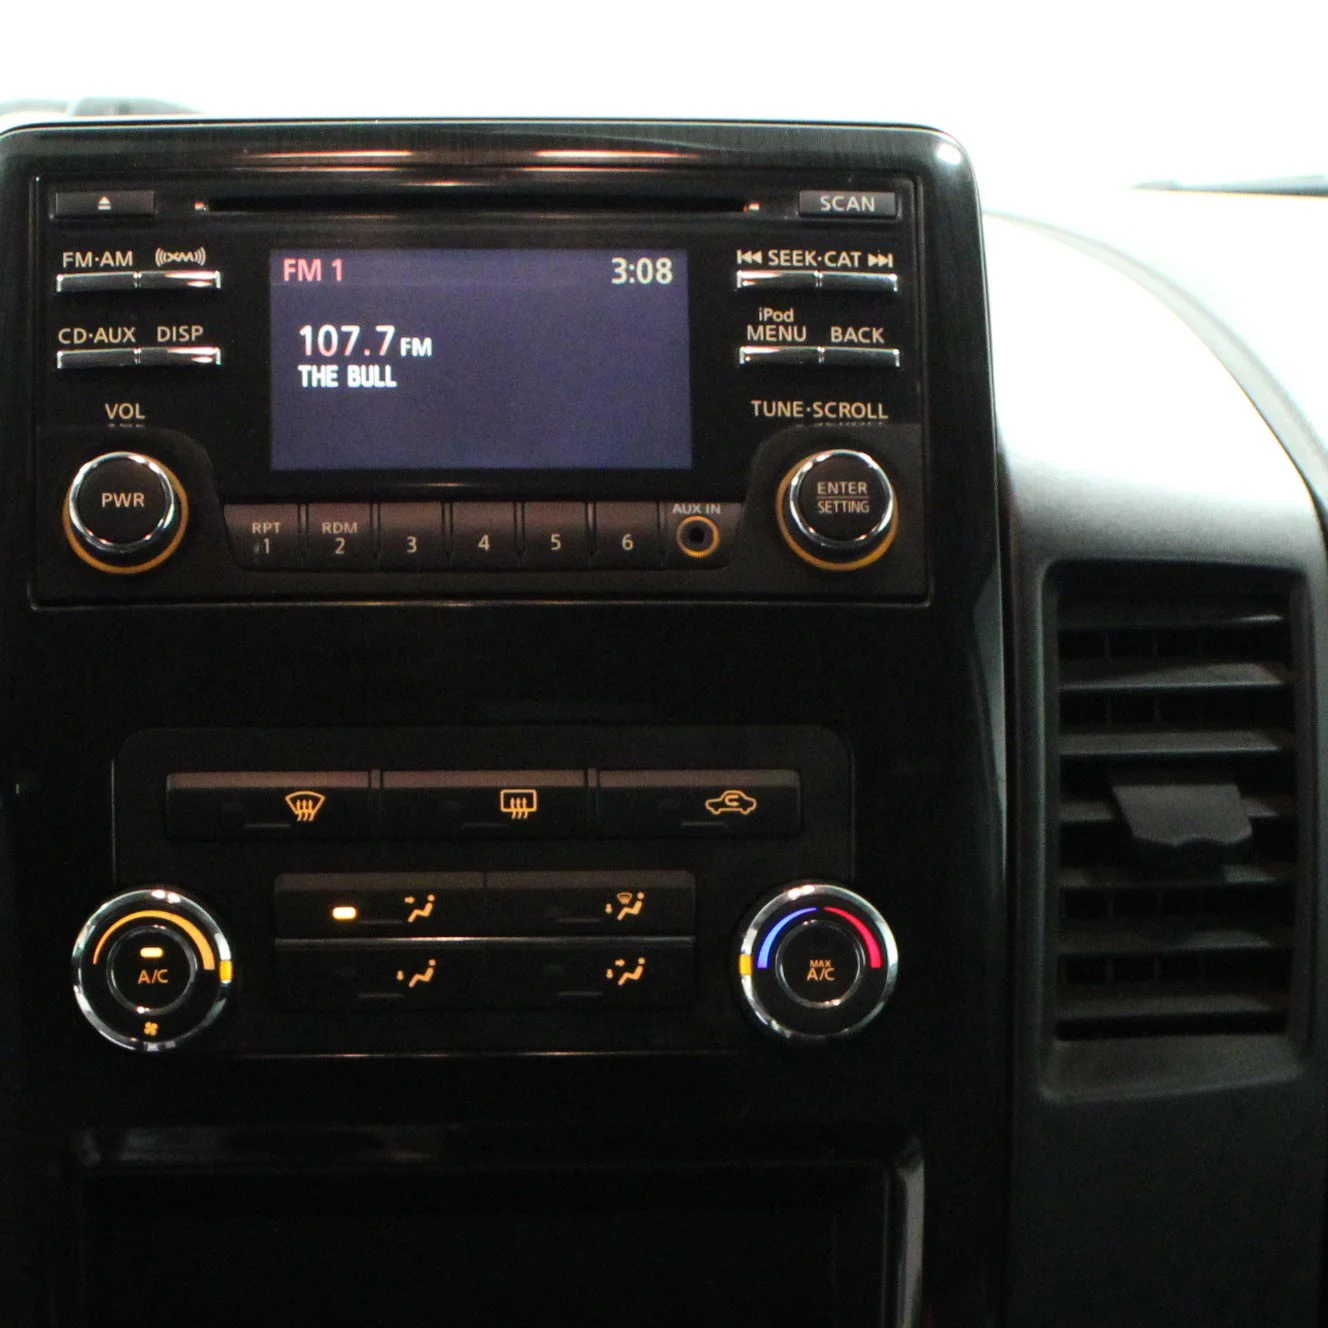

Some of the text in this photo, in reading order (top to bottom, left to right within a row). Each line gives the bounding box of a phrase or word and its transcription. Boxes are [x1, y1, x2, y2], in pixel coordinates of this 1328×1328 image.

[820, 196, 875, 212] SCAN
[282, 258, 344, 281] FM 1
[611, 257, 672, 284] 3:08
[759, 307, 794, 322] iPod
[157, 325, 204, 342] DISP
[298, 325, 432, 357] 107.7 FM
[747, 325, 807, 342] MENU
[830, 327, 884, 344] BACK
[298, 364, 397, 388] THE BULL
[105, 403, 145, 420] VOL
[817, 481, 868, 495] ENTER
[101, 493, 145, 508] PWR
[817, 499, 870, 514] SETTING
[672, 502, 721, 516] AUX IN
[252, 522, 281, 535] RPT
[322, 522, 358, 534] RDM
[263, 538, 270, 553] 1
[334, 538, 345, 554] 2
[407, 536, 417, 552] 3
[478, 534, 490, 551] 4
[550, 534, 561, 550] 5
[621, 533, 633, 551] 6
[809, 959, 832, 968] MAX
[138, 968, 169, 984] A/C
[807, 967, 835, 981] A/C
